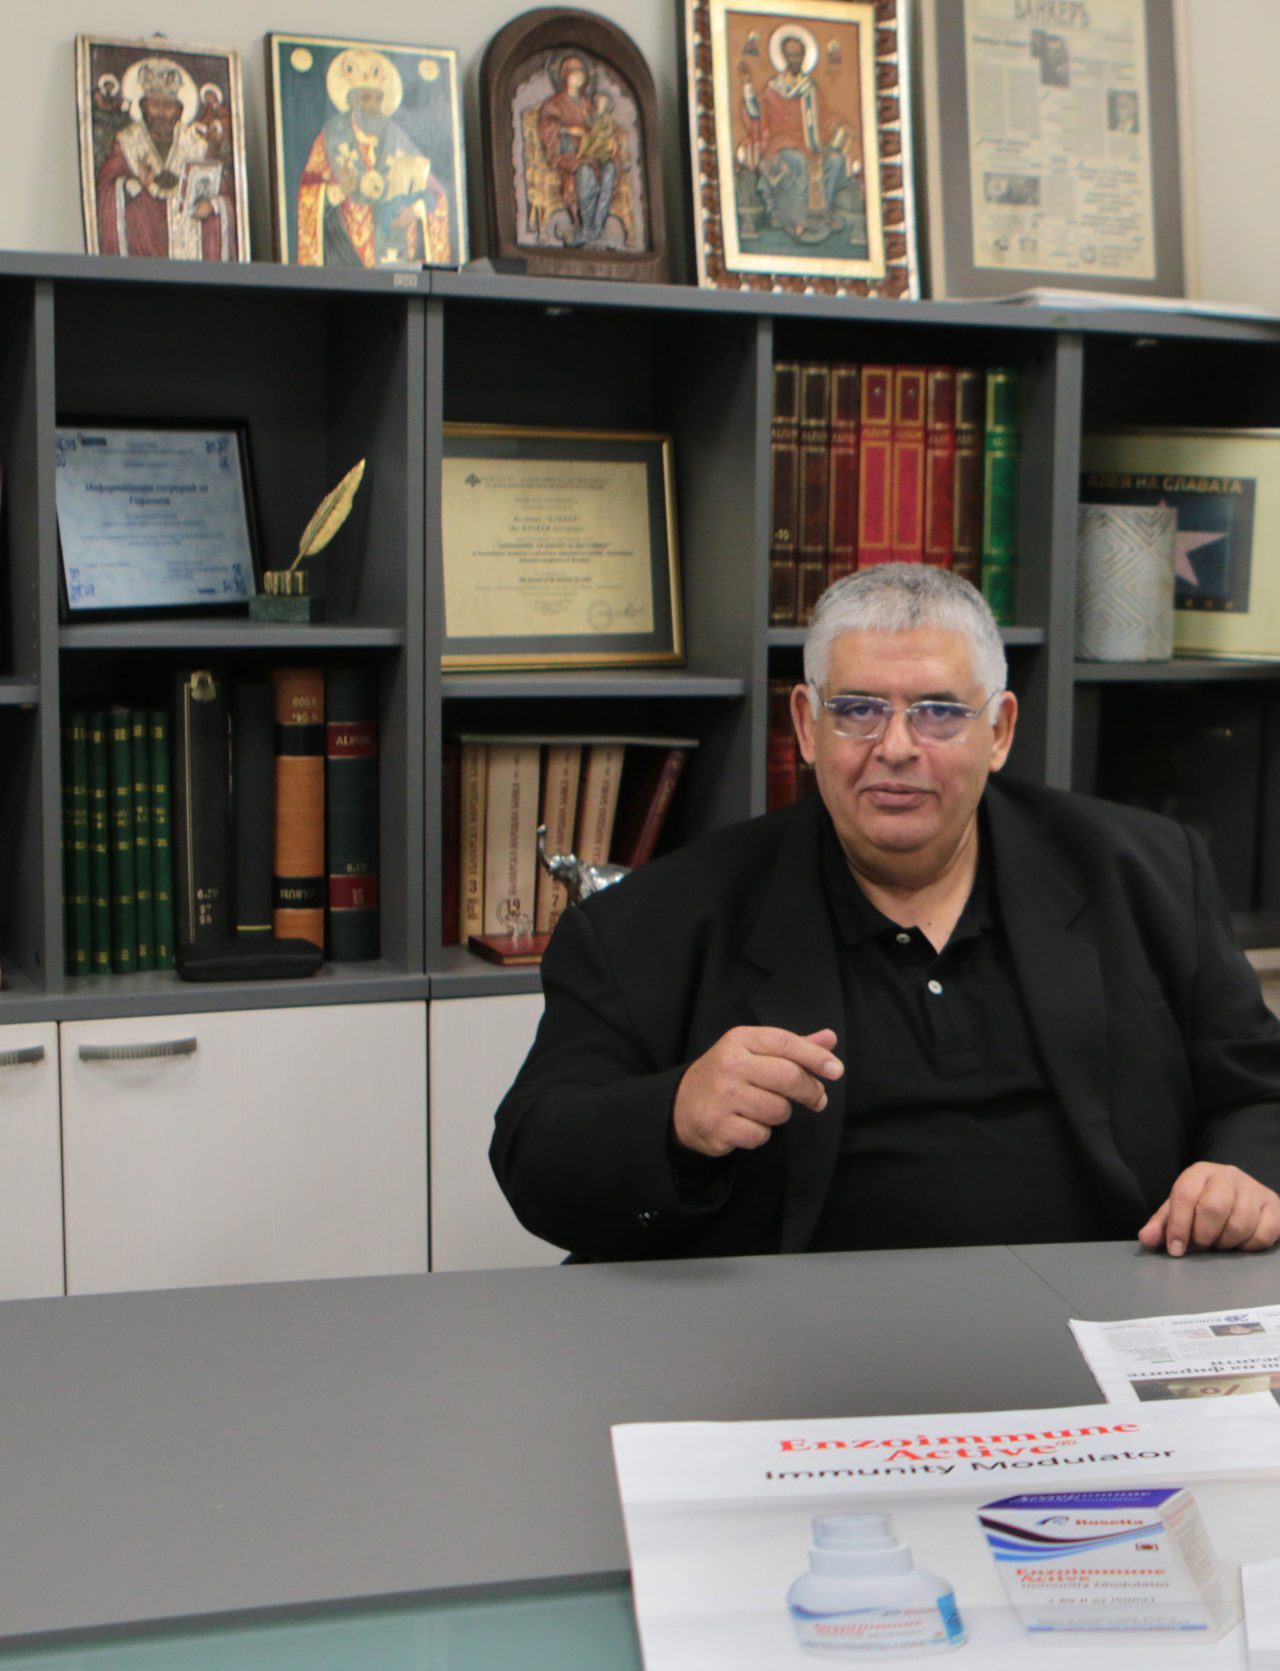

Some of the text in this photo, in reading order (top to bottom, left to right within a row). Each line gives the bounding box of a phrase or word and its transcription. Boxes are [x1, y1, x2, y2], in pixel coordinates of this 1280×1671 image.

[1162, 477, 1243, 493] СЛАВАТА
[777, 1422, 1142, 1453] Enzoimmune
[765, 1448, 1177, 1481] Immunity Modulator
[1016, 1567, 1167, 1576] Enzoimmune
